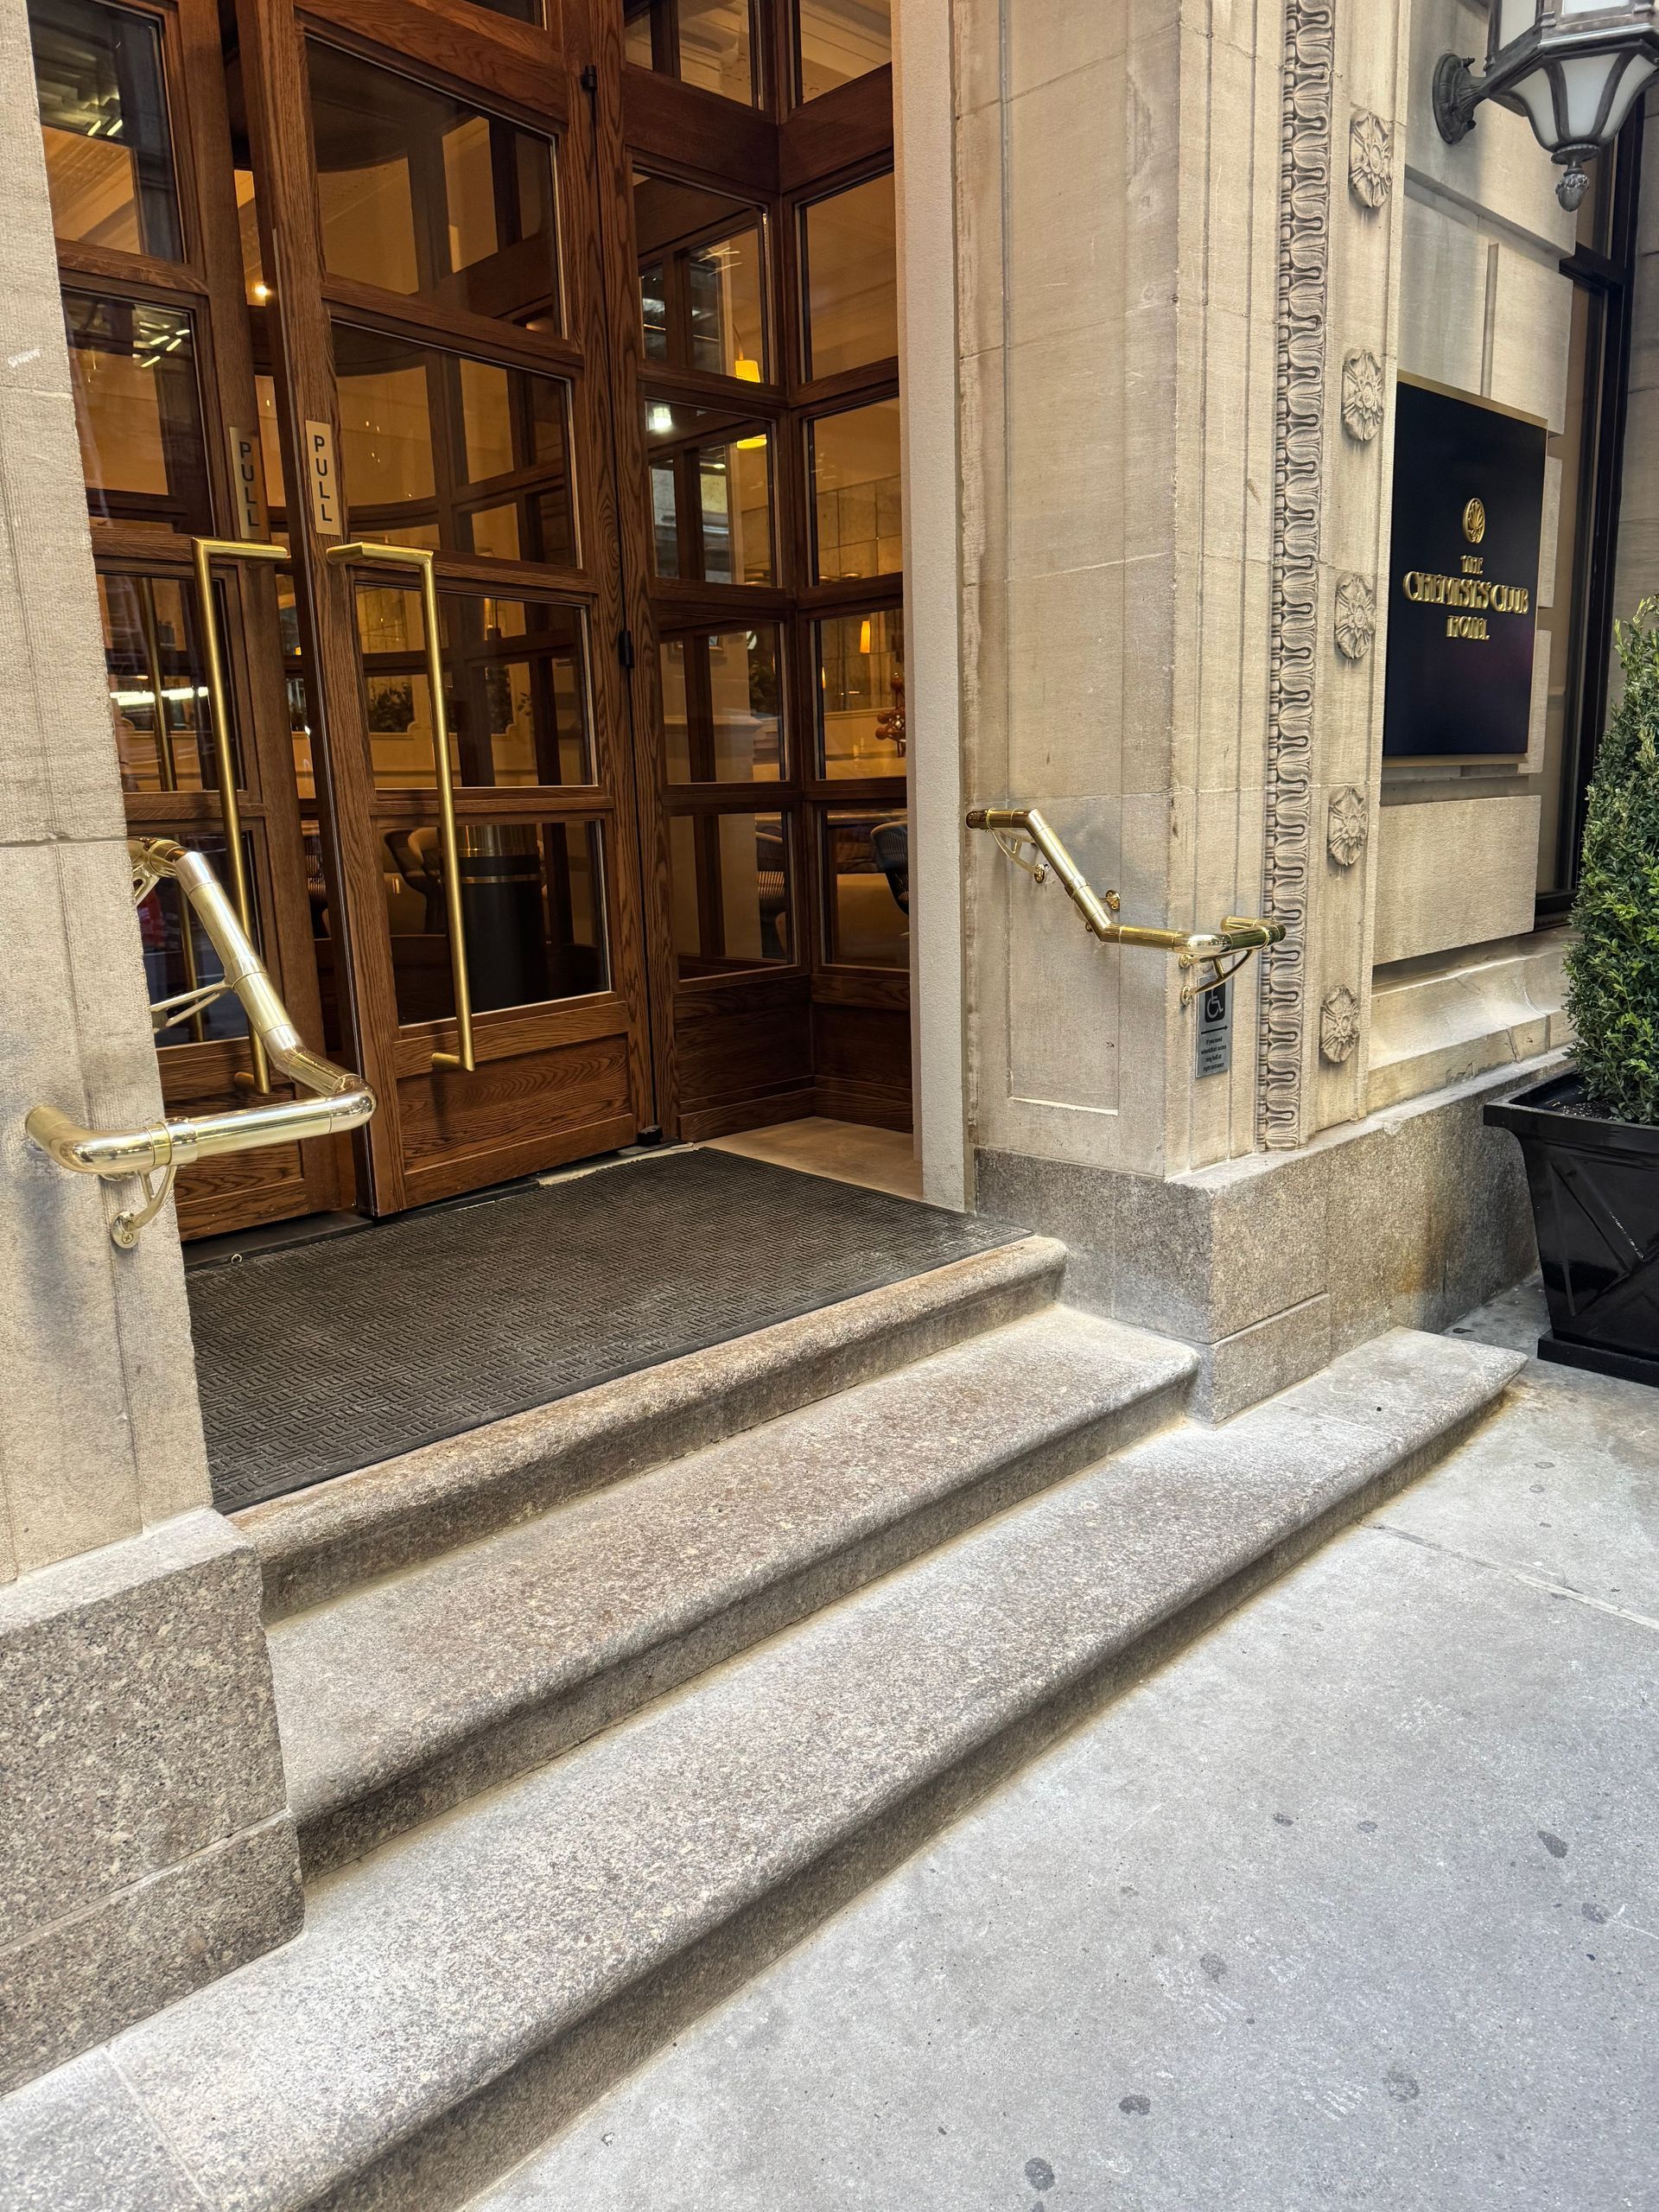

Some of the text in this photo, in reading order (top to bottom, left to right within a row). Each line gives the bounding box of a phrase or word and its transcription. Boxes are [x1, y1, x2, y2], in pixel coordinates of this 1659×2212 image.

[238, 441, 260, 527] PULL
[314, 435, 333, 522] PULL
[1460, 554, 1484, 575] THE
[1491, 584, 1530, 615] CLUB
[1446, 614, 1491, 641] HOTEL
